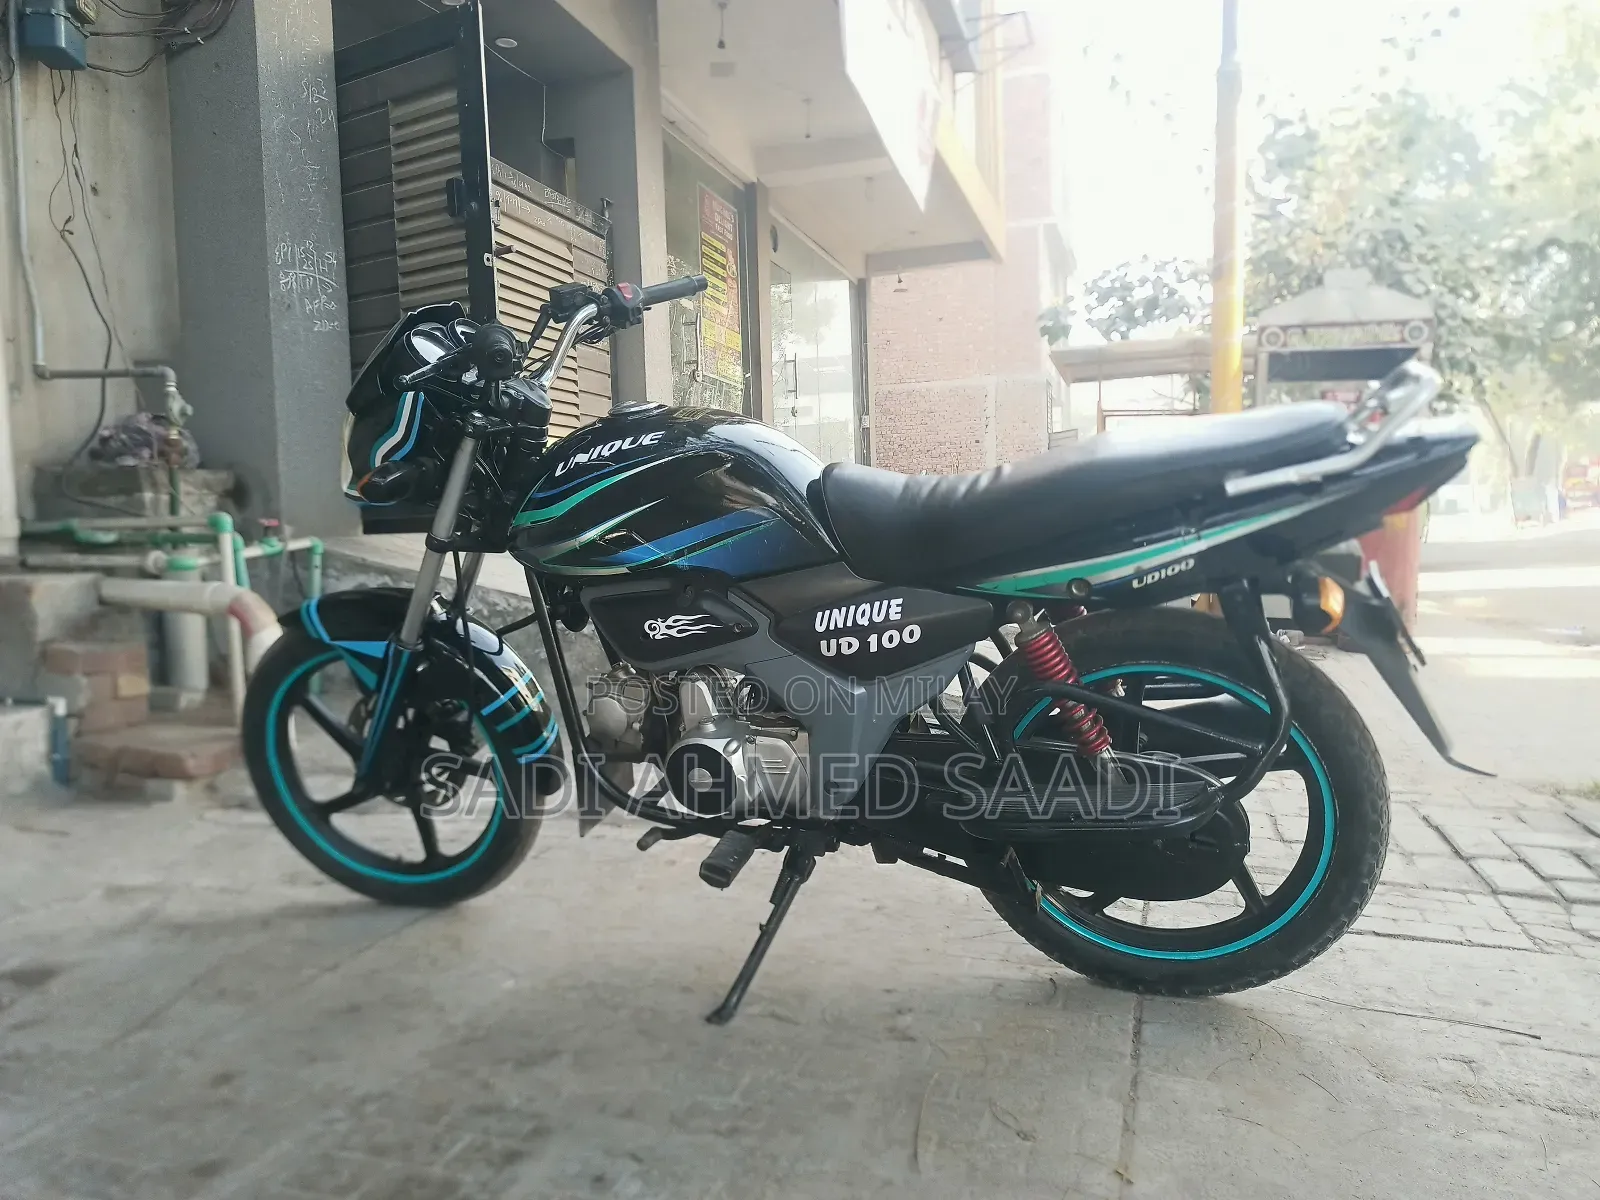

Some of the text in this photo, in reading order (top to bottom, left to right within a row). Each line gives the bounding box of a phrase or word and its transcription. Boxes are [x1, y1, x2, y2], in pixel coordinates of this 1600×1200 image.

[555, 430, 666, 477] UNIQUE
[1132, 558, 1195, 589] UD100
[814, 598, 904, 633] UNIQUE
[820, 624, 922, 657] UD 100
